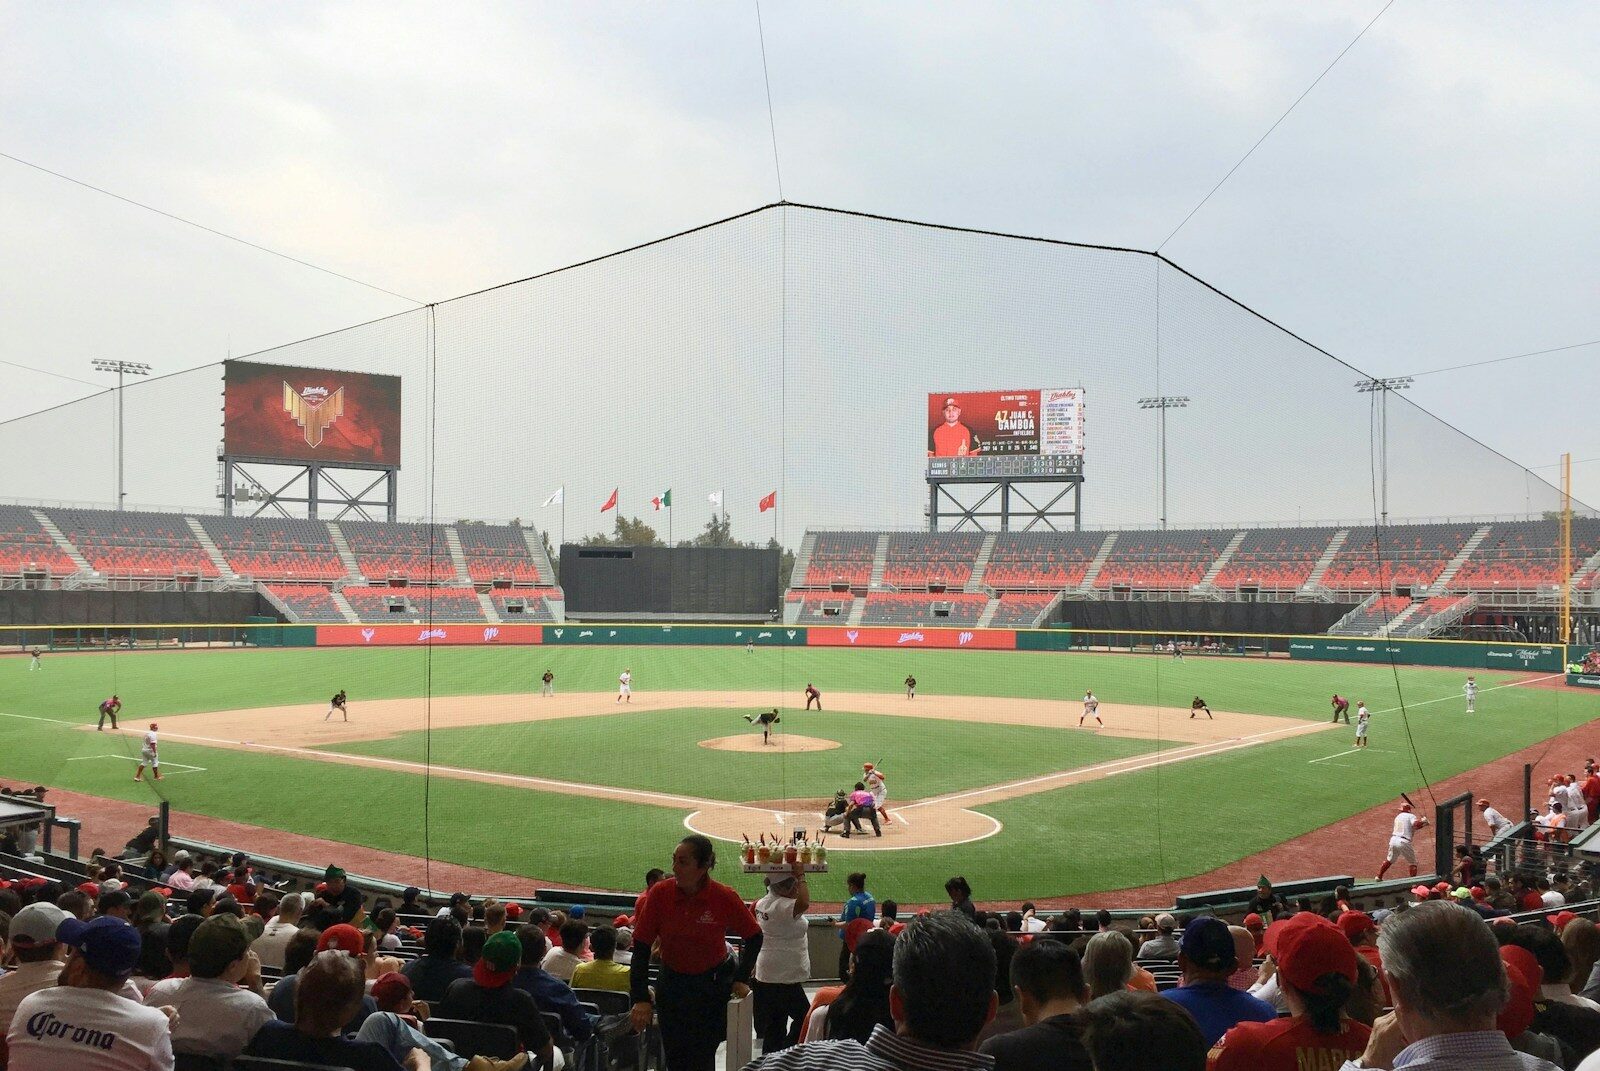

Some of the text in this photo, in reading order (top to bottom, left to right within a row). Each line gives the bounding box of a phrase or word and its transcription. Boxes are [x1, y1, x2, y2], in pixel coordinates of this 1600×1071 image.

[994, 410, 1034, 421] 47 JUAN C.
[998, 419, 1034, 430] GAMBOA
[27, 1011, 116, 1050] Corona
